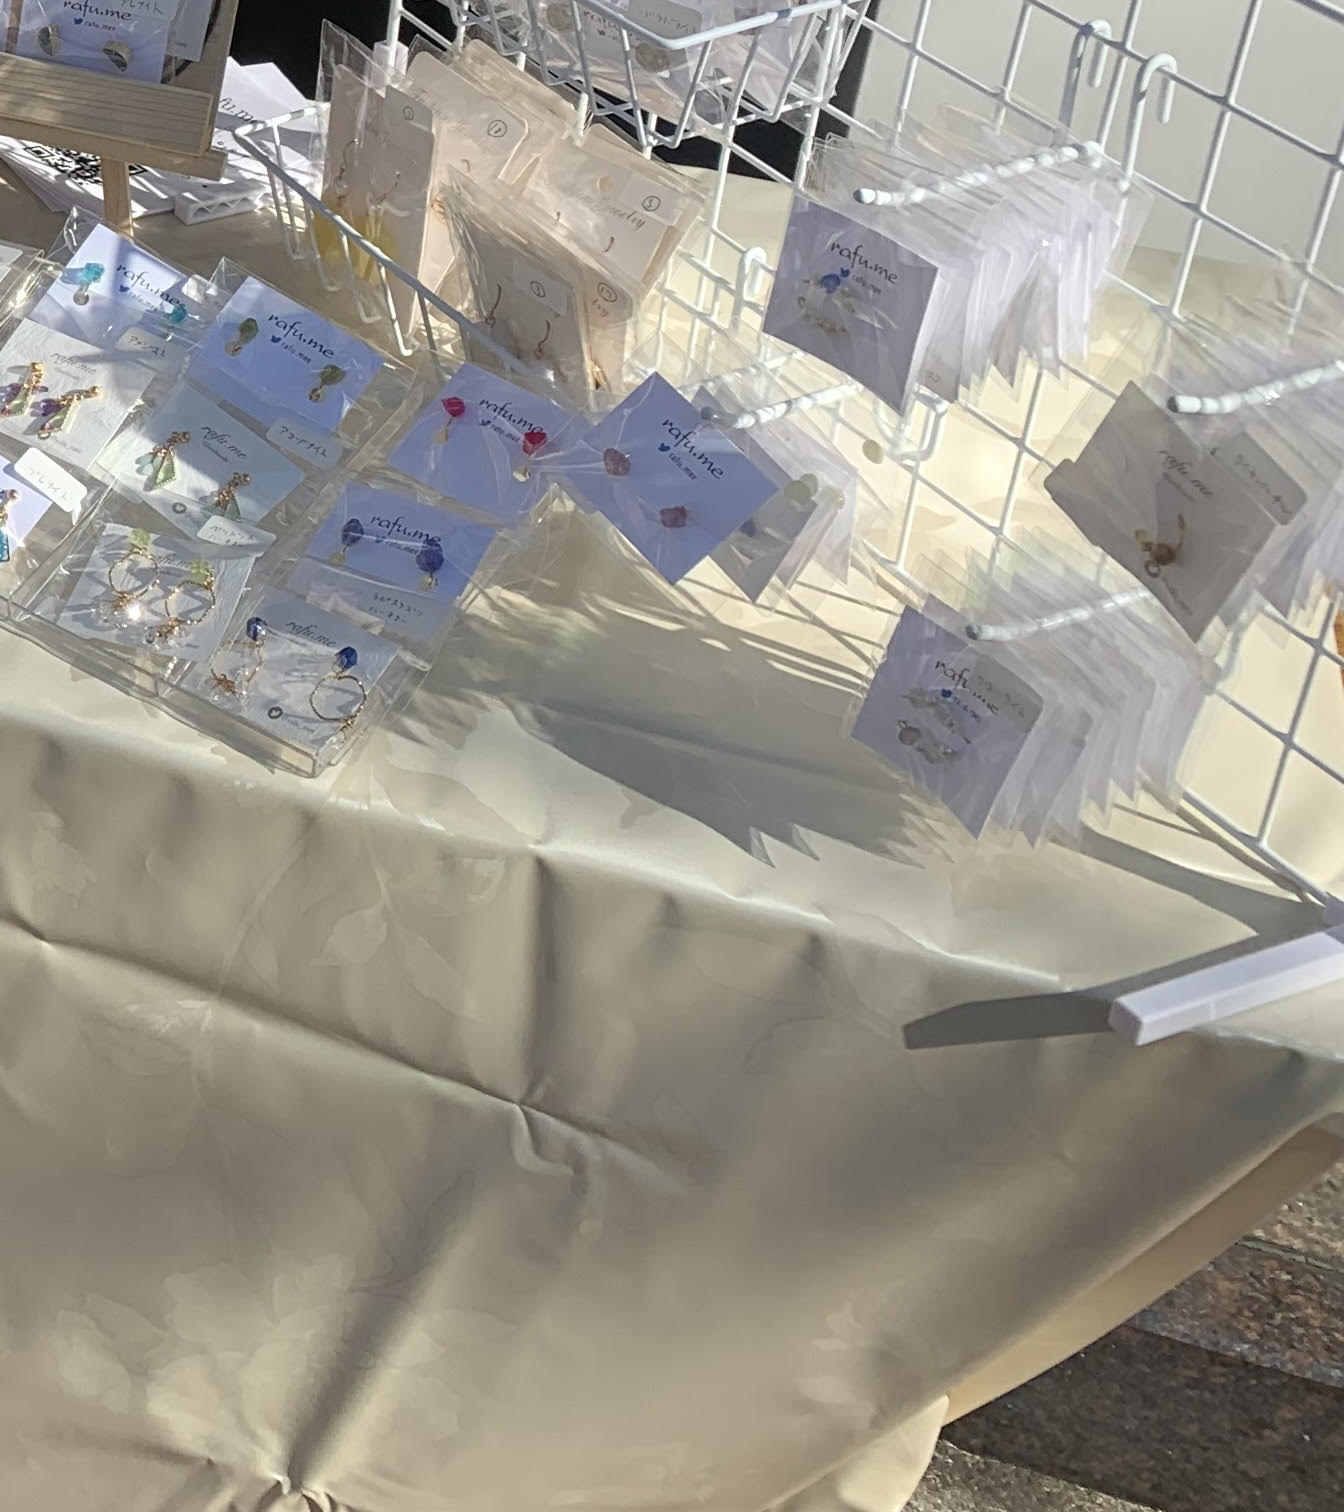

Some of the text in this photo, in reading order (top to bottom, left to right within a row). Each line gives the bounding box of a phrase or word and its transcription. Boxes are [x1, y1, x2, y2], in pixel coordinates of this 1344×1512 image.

[830, 241, 899, 285] rafu.me
[116, 264, 186, 308] rafu.me
[268, 314, 335, 359] rafu.me
[478, 397, 544, 432] rafu.me
[661, 417, 725, 480] rafu.me
[370, 514, 442, 546] rafu.me
